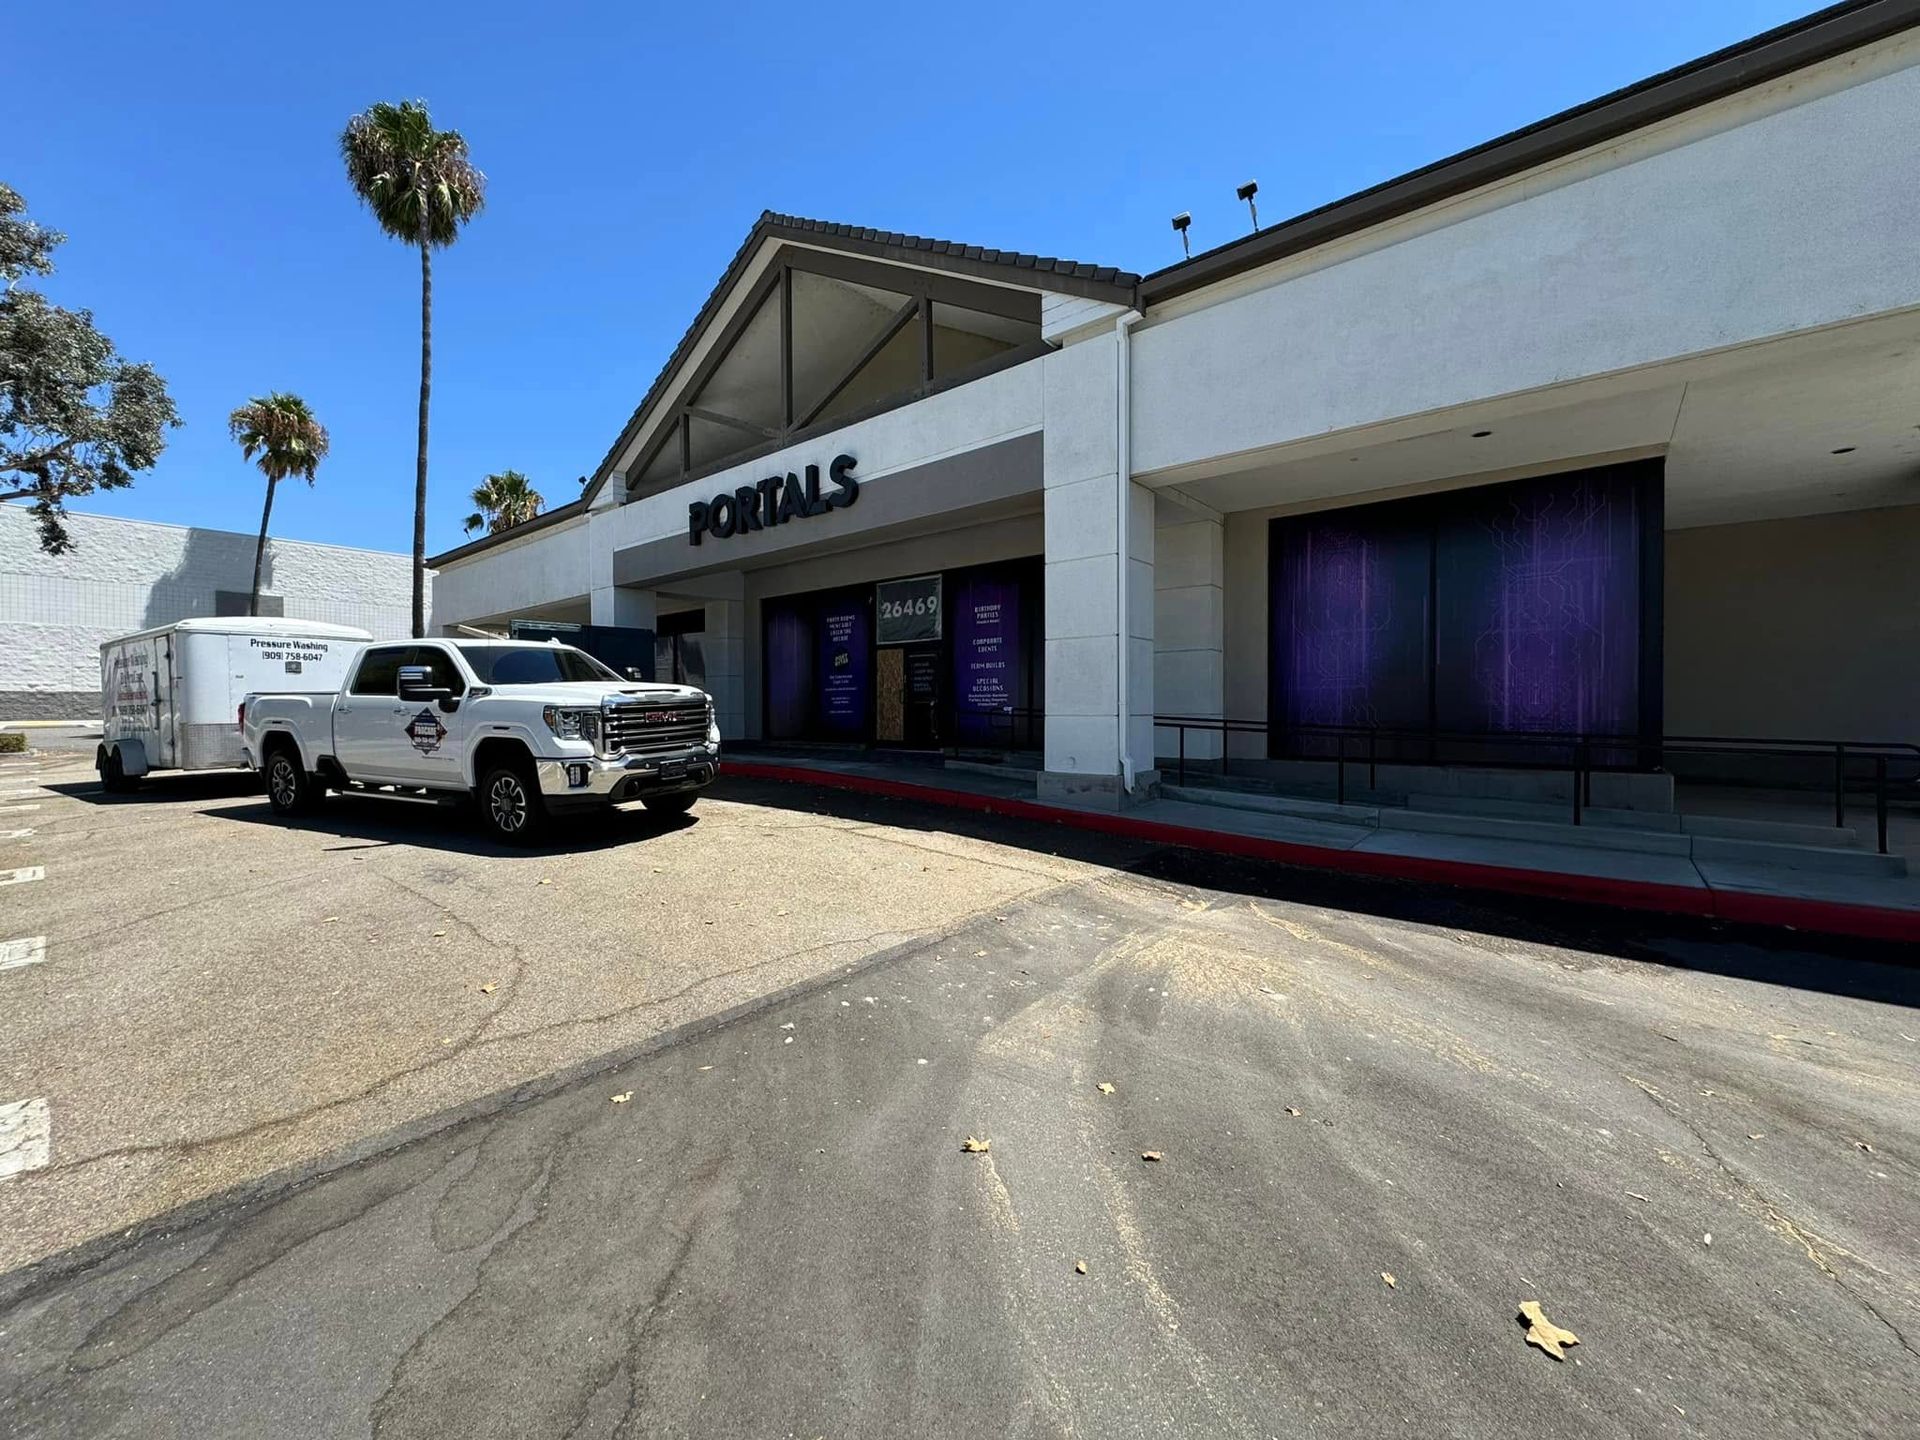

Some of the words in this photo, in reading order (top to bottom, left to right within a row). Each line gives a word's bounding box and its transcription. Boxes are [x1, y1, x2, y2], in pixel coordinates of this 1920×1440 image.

[689, 454, 859, 546] PORTALS
[881, 596, 937, 619] 26469
[250, 638, 292, 648] Pressure
[292, 641, 329, 653] Washing
[285, 652, 323, 661] 758-6047
[645, 711, 686, 724] GMC
